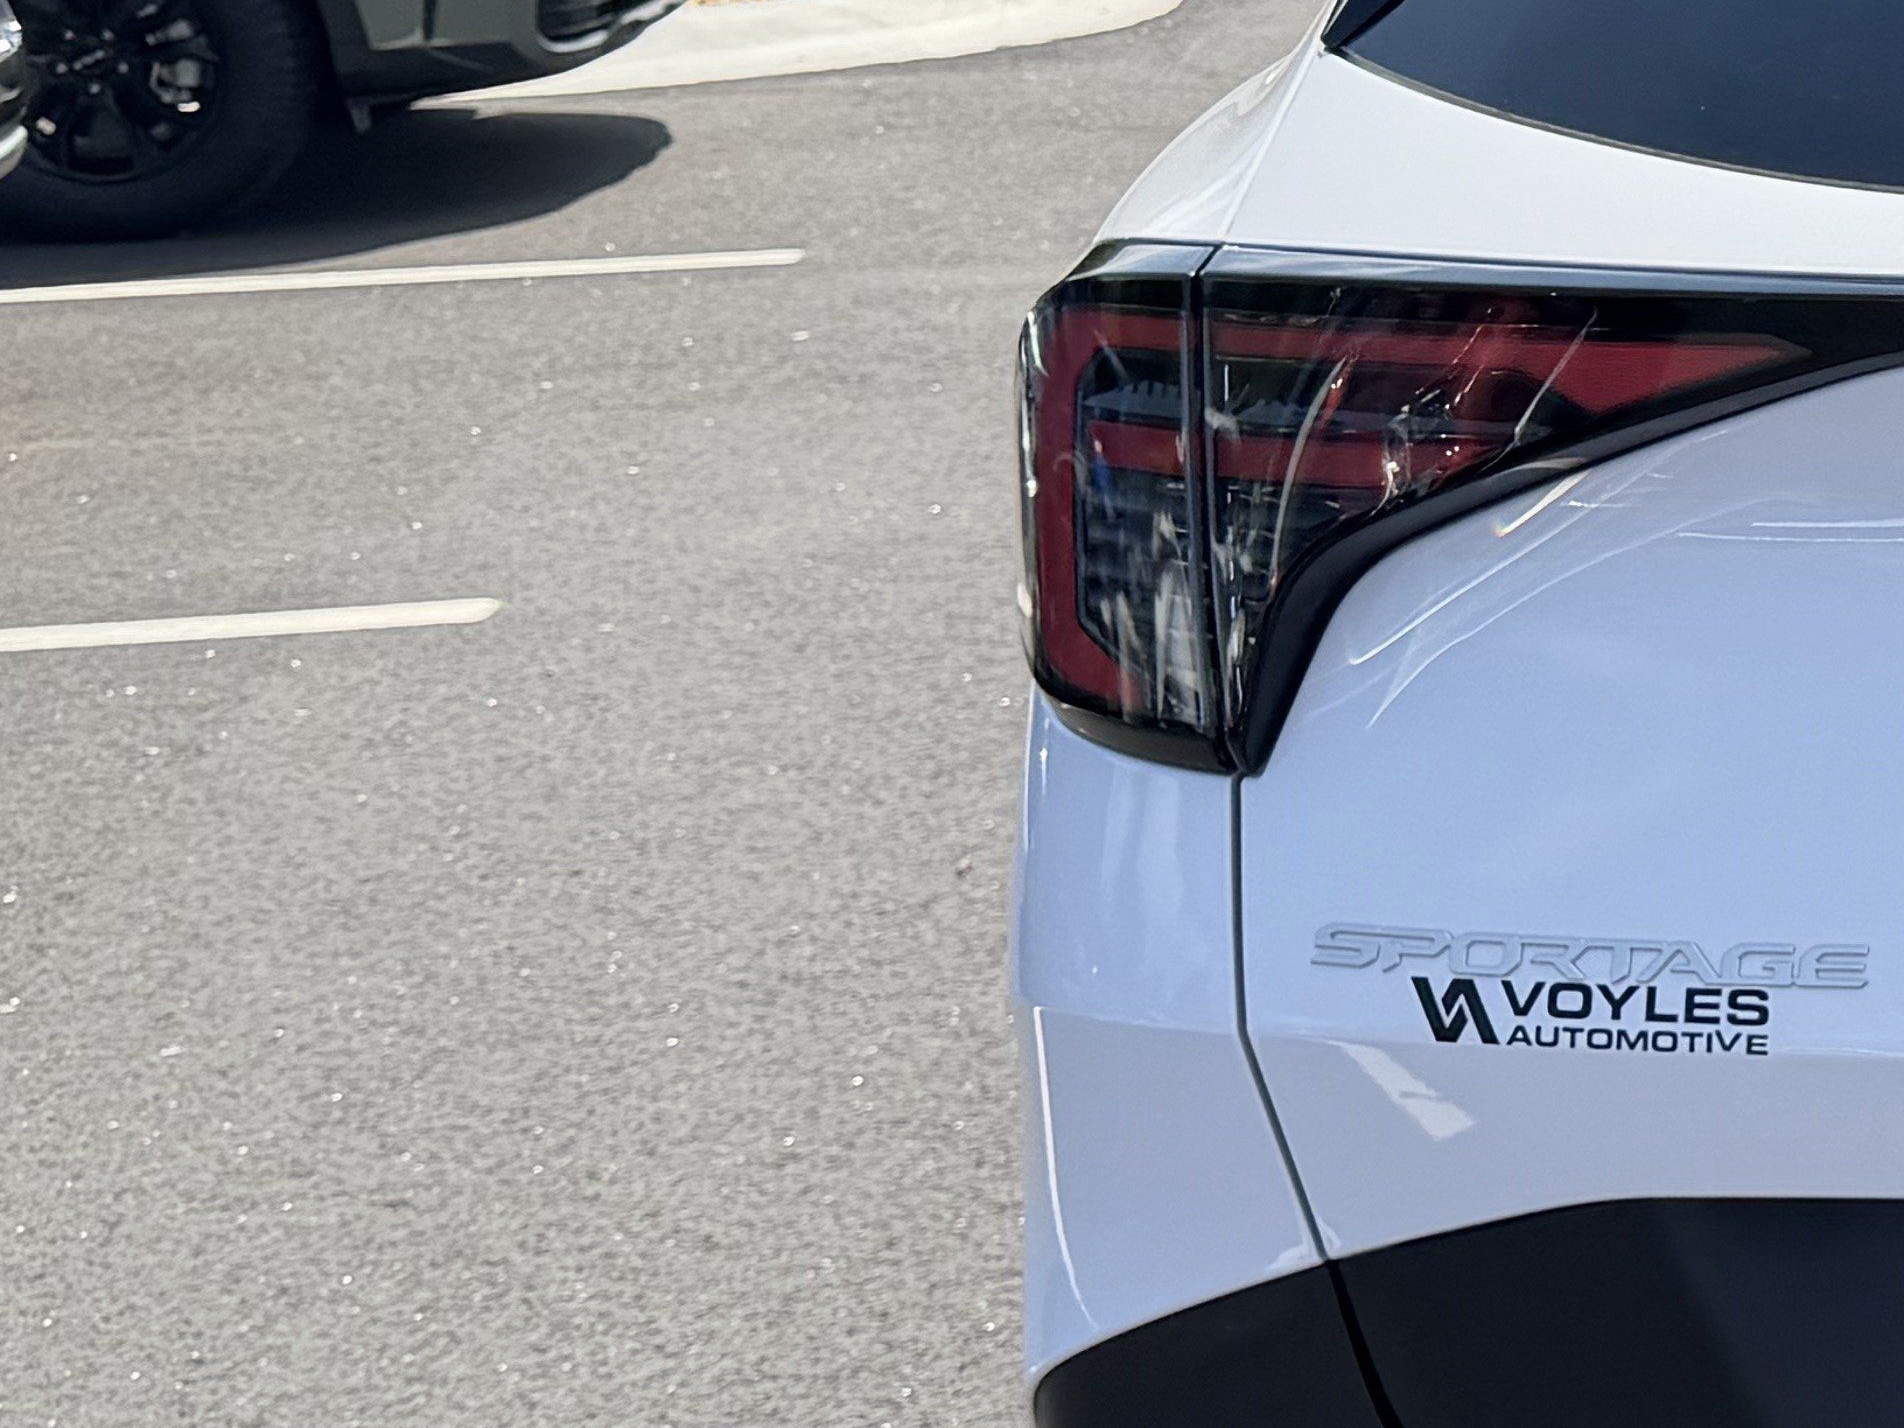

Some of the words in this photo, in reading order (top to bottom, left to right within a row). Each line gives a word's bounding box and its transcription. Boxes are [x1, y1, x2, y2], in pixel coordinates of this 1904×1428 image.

[1310, 921, 1870, 990] SPORTAGE
[1501, 979, 1770, 1026] VOYLES
[1506, 1025, 1769, 1056] AUTOMOTIVE
